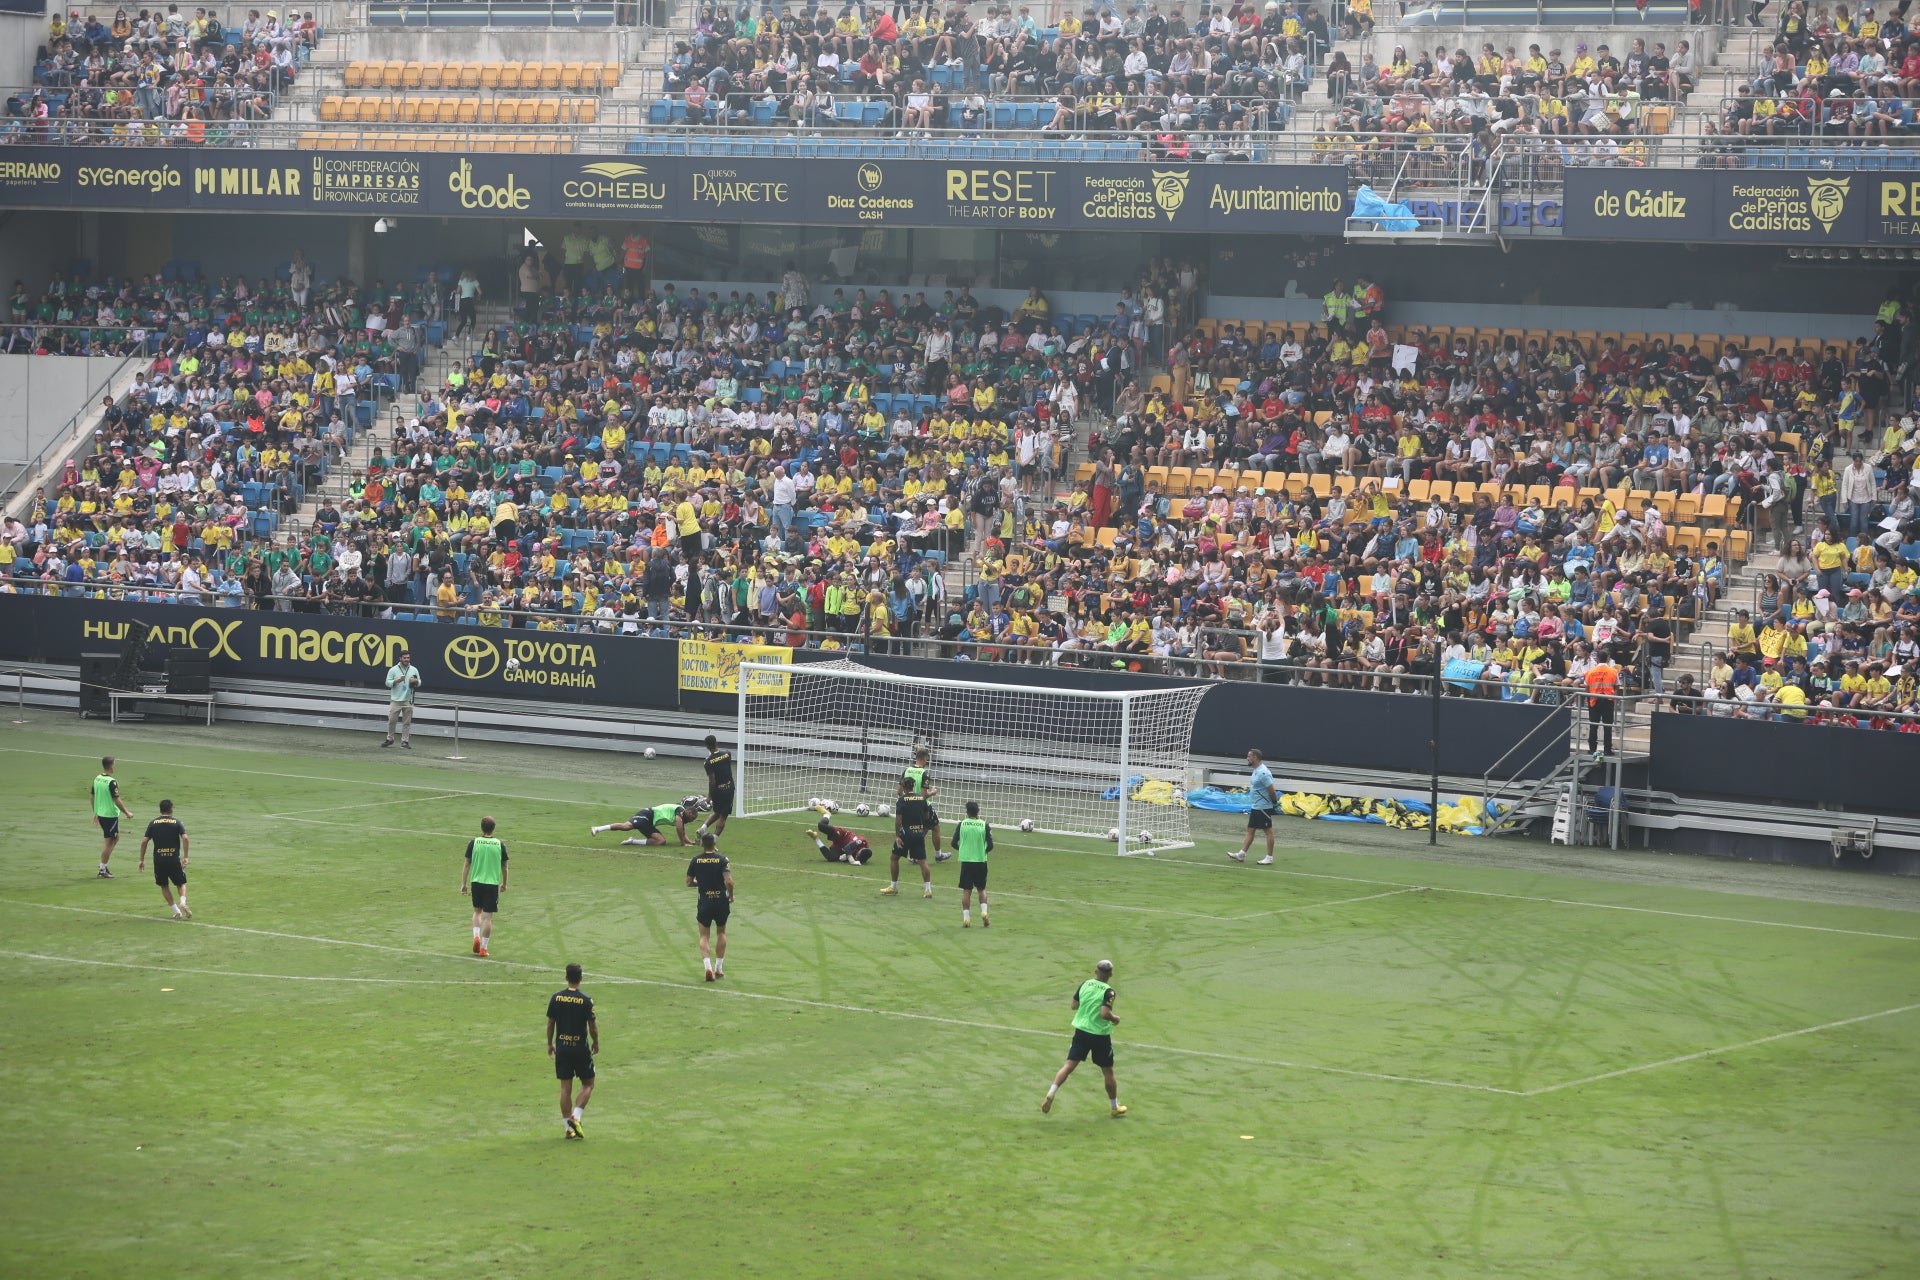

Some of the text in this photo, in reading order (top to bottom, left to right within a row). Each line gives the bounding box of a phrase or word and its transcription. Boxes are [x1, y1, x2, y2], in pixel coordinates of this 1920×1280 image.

[325, 159, 420, 173] CONFEDERACIÓN
[221, 168, 301, 195] MILAR
[325, 173, 420, 189] EMPRESAS
[946, 169, 1057, 202] RESET
[1085, 176, 1145, 189] Federación
[325, 191, 419, 204] PROVINCIA DE CÁDIZ
[563, 181, 666, 200] COHEBU
[1107, 187, 1152, 204] Peñas
[1209, 183, 1342, 215] Ayuntamiento
[1732, 185, 1799, 199] Federación
[858, 195, 914, 209] Cadenas
[1082, 201, 1156, 219] Cadistas
[1594, 189, 1686, 218] de Cádiz
[1757, 197, 1808, 215] Peñas
[858, 210, 883, 220] CASH
[947, 204, 1056, 220] THE ART OF BODY
[1501, 201, 1532, 227] DE
[1537, 201, 1563, 227] C
[1729, 212, 1811, 231] Cadistas
[1880, 221, 1909, 235] THE
[260, 625, 409, 668] macron
[503, 638, 597, 668] TOYOTA
[681, 658, 709, 673] DOCTOR
[503, 667, 596, 689] GAMO BAHÍA
[555, 994, 584, 1004] macron
